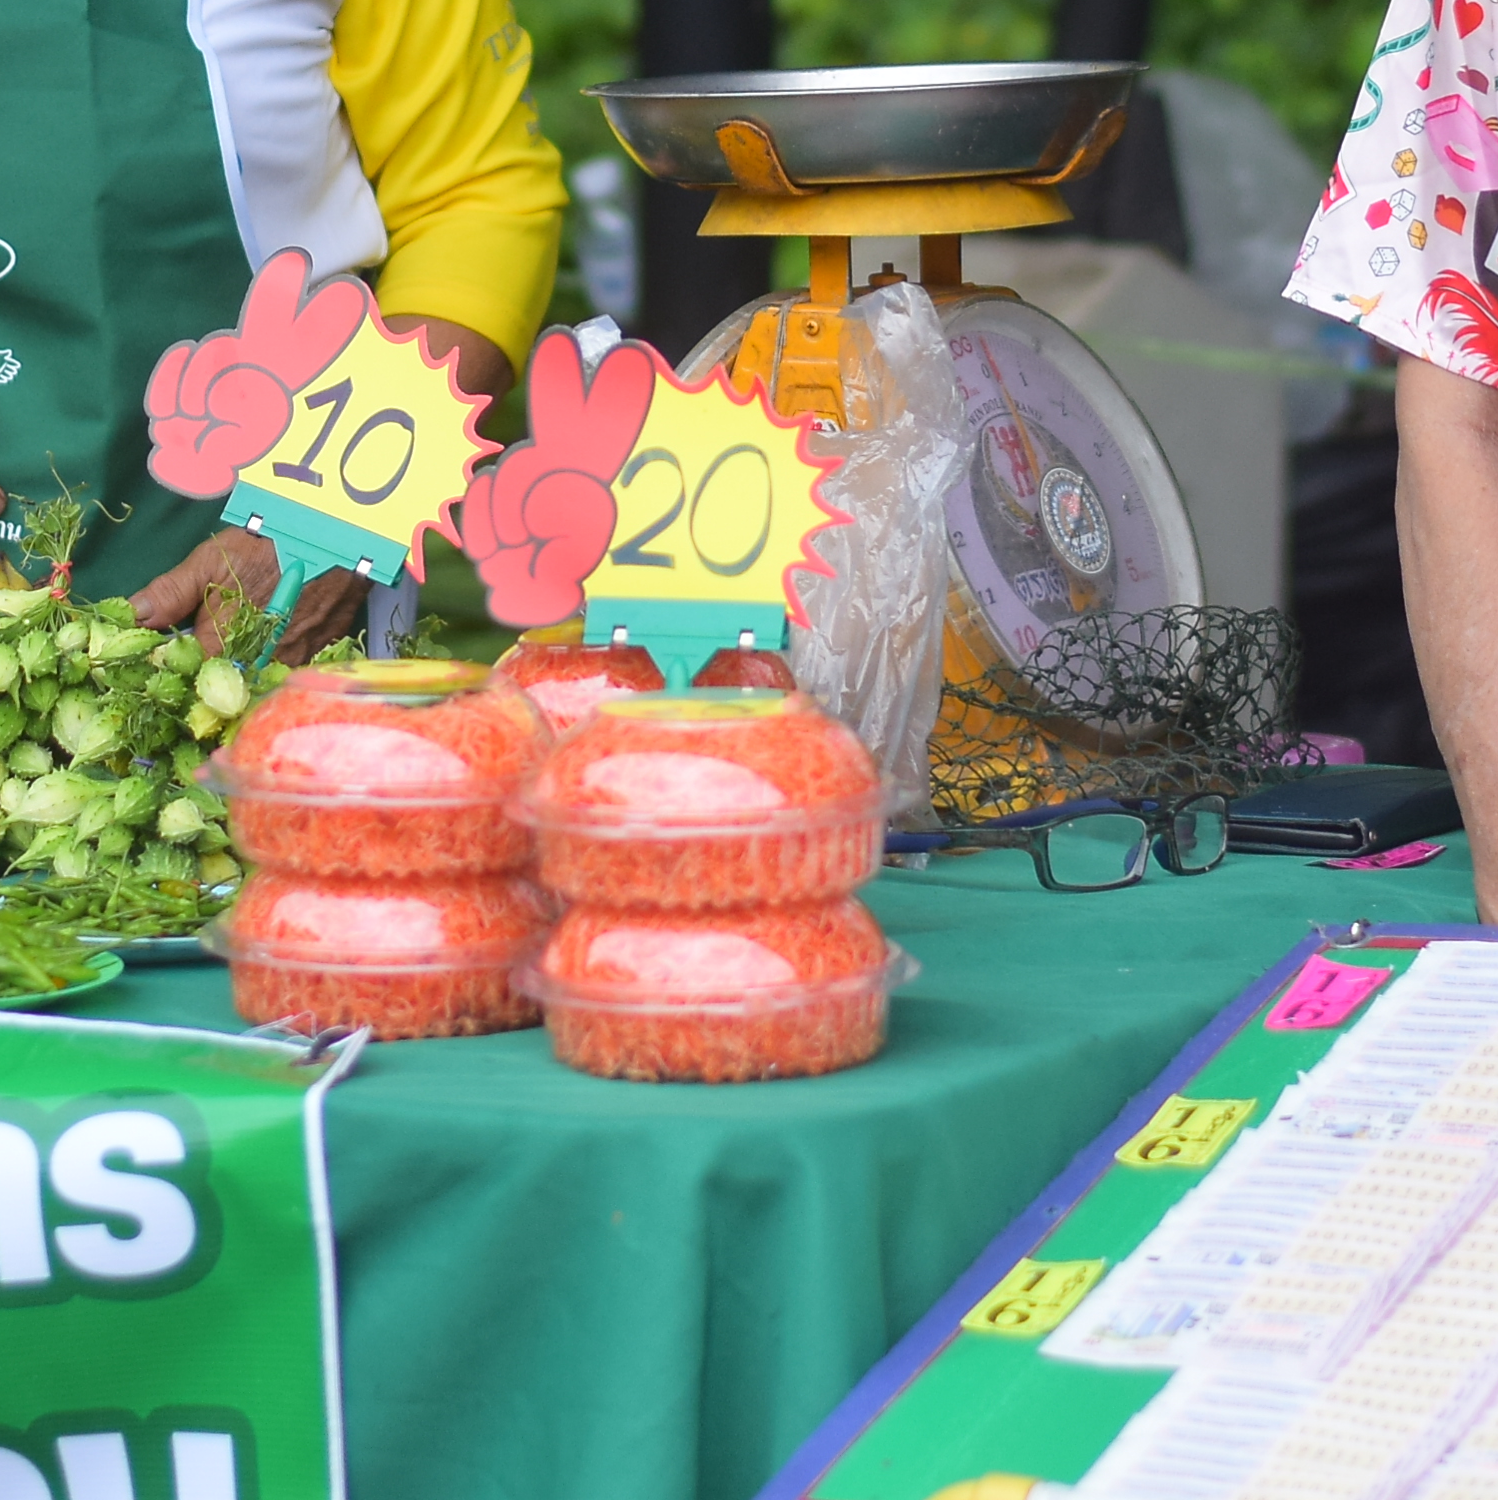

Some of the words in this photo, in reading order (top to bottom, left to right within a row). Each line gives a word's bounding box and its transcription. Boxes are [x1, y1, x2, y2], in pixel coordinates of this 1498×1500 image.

[272, 377, 415, 506] 10
[608, 444, 772, 576] 20
[1013, 623, 1038, 655] 10
[1173, 1105, 1199, 1129] 1
[1138, 1134, 1189, 1162] 6
[1021, 1267, 1051, 1292] 1
[986, 1297, 1038, 1327] 6
